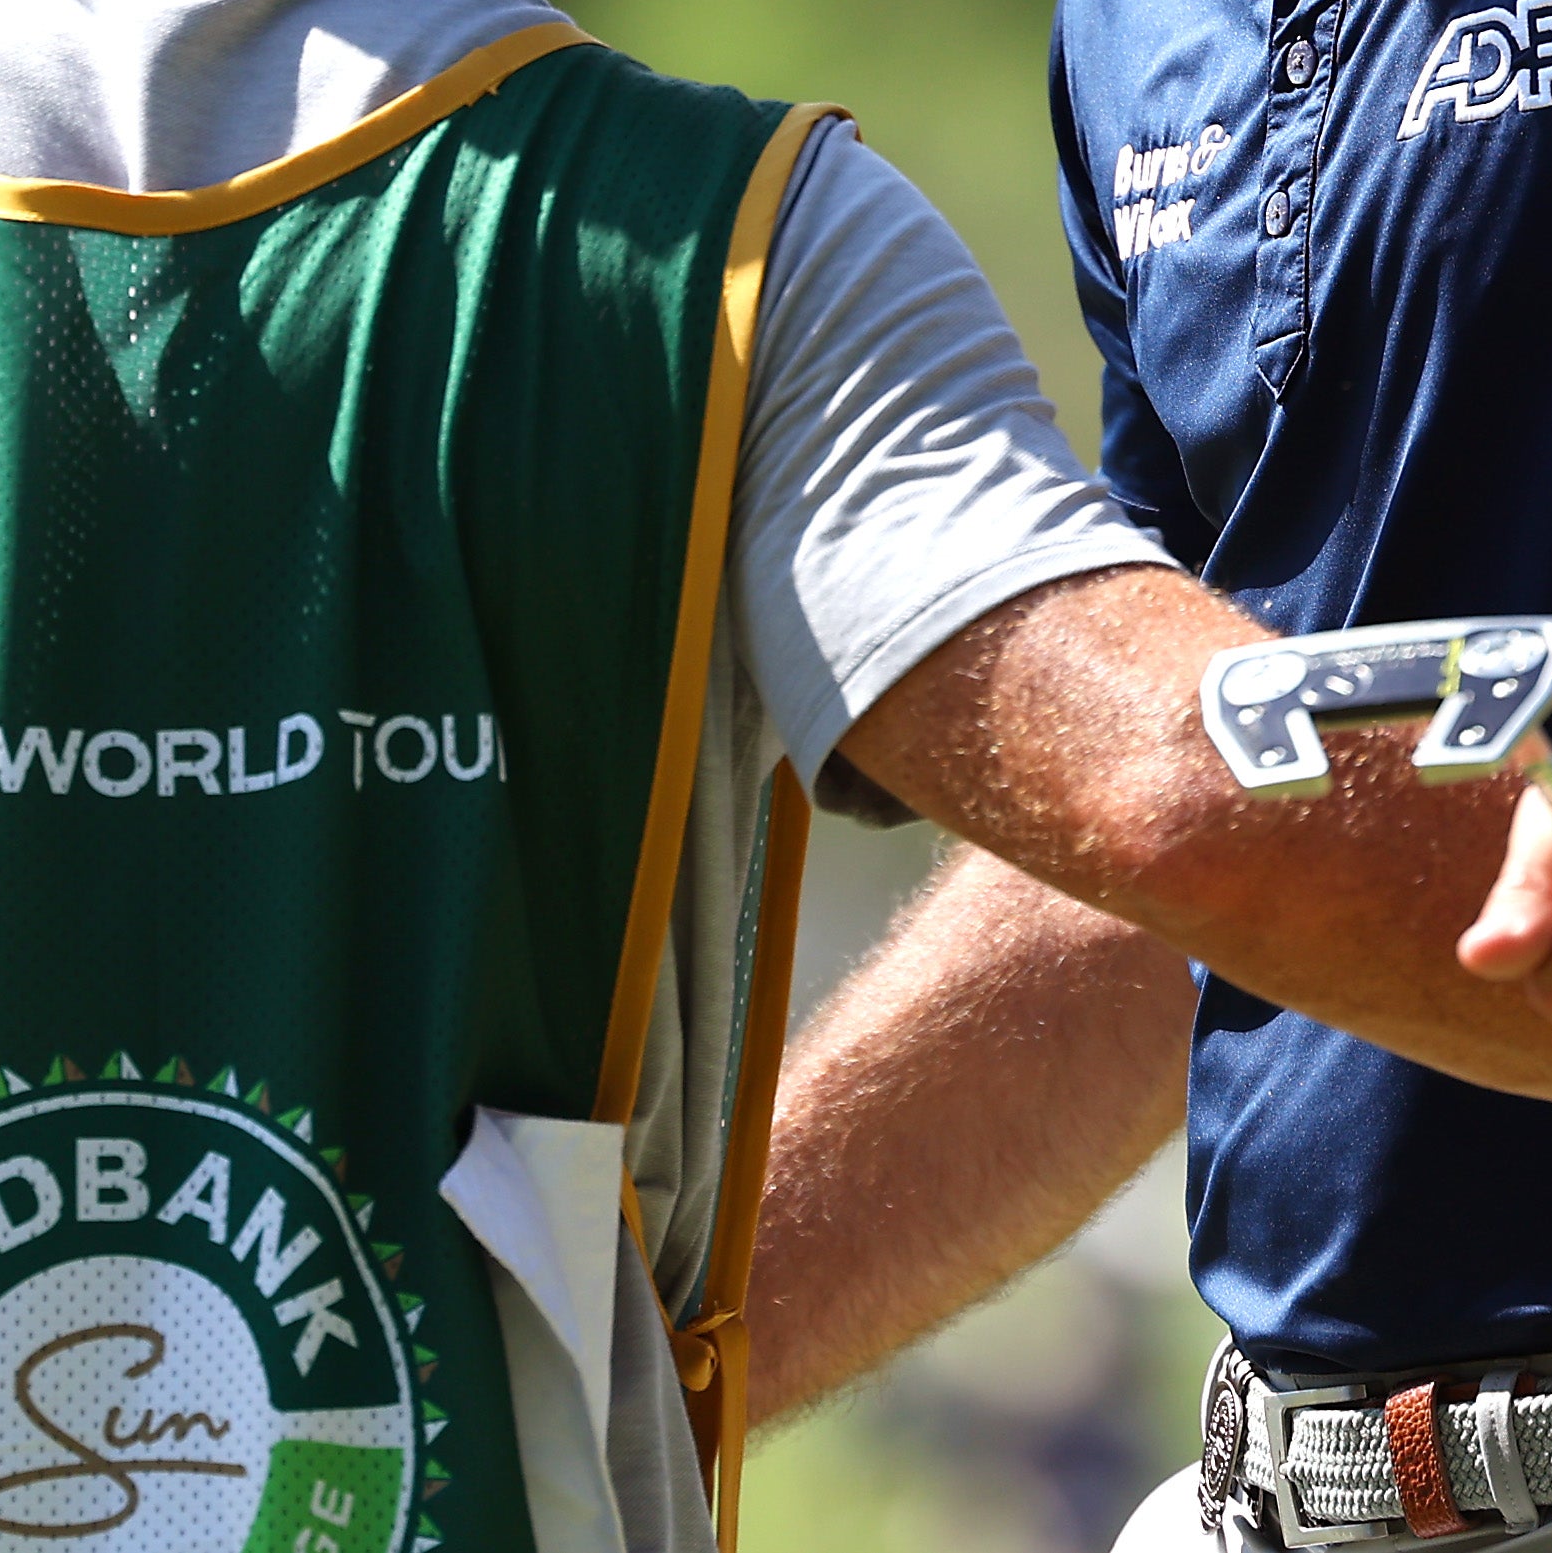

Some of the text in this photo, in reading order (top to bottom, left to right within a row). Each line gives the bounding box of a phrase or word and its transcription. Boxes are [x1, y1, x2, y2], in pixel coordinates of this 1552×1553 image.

[1114, 123, 1232, 200] Burns &
[338, 710, 507, 794] TOU
